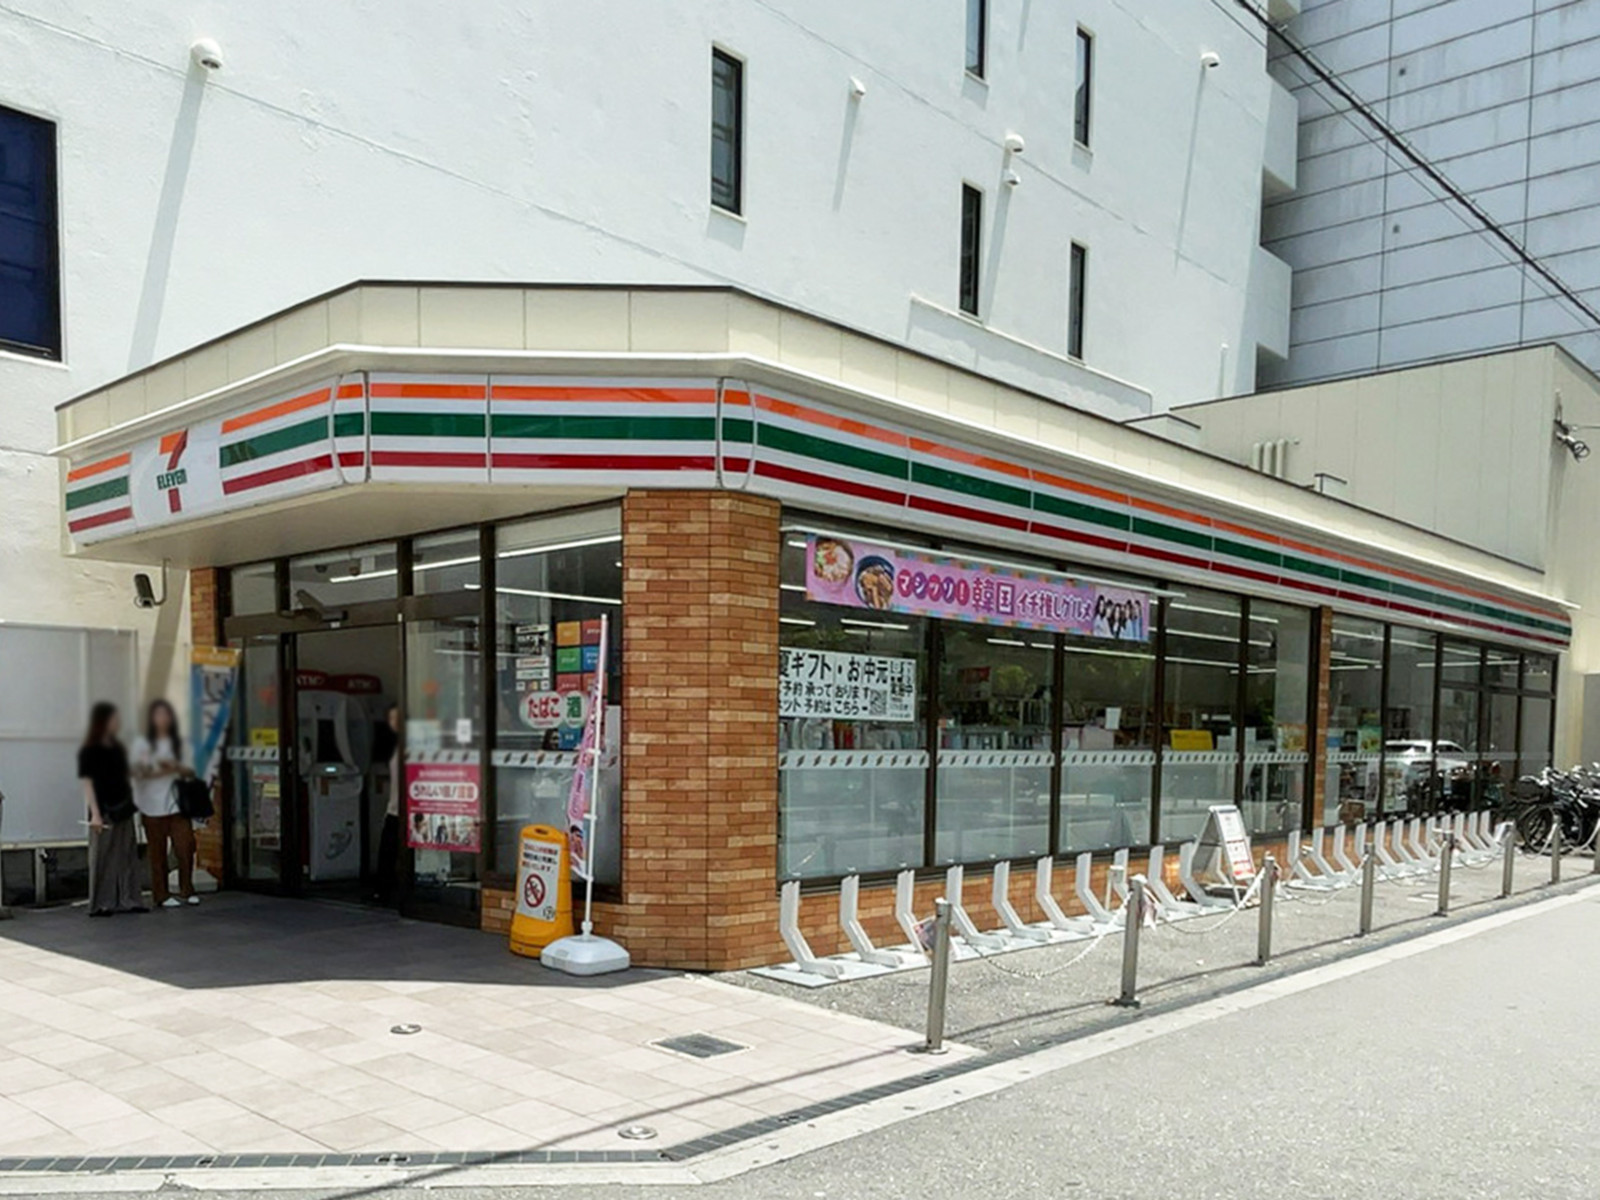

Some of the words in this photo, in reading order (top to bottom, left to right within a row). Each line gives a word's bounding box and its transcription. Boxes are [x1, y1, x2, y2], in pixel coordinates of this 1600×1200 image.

[160, 428, 188, 513] 7
[779, 680, 870, 700] 予約承っております
[528, 696, 561, 719] たばこ
